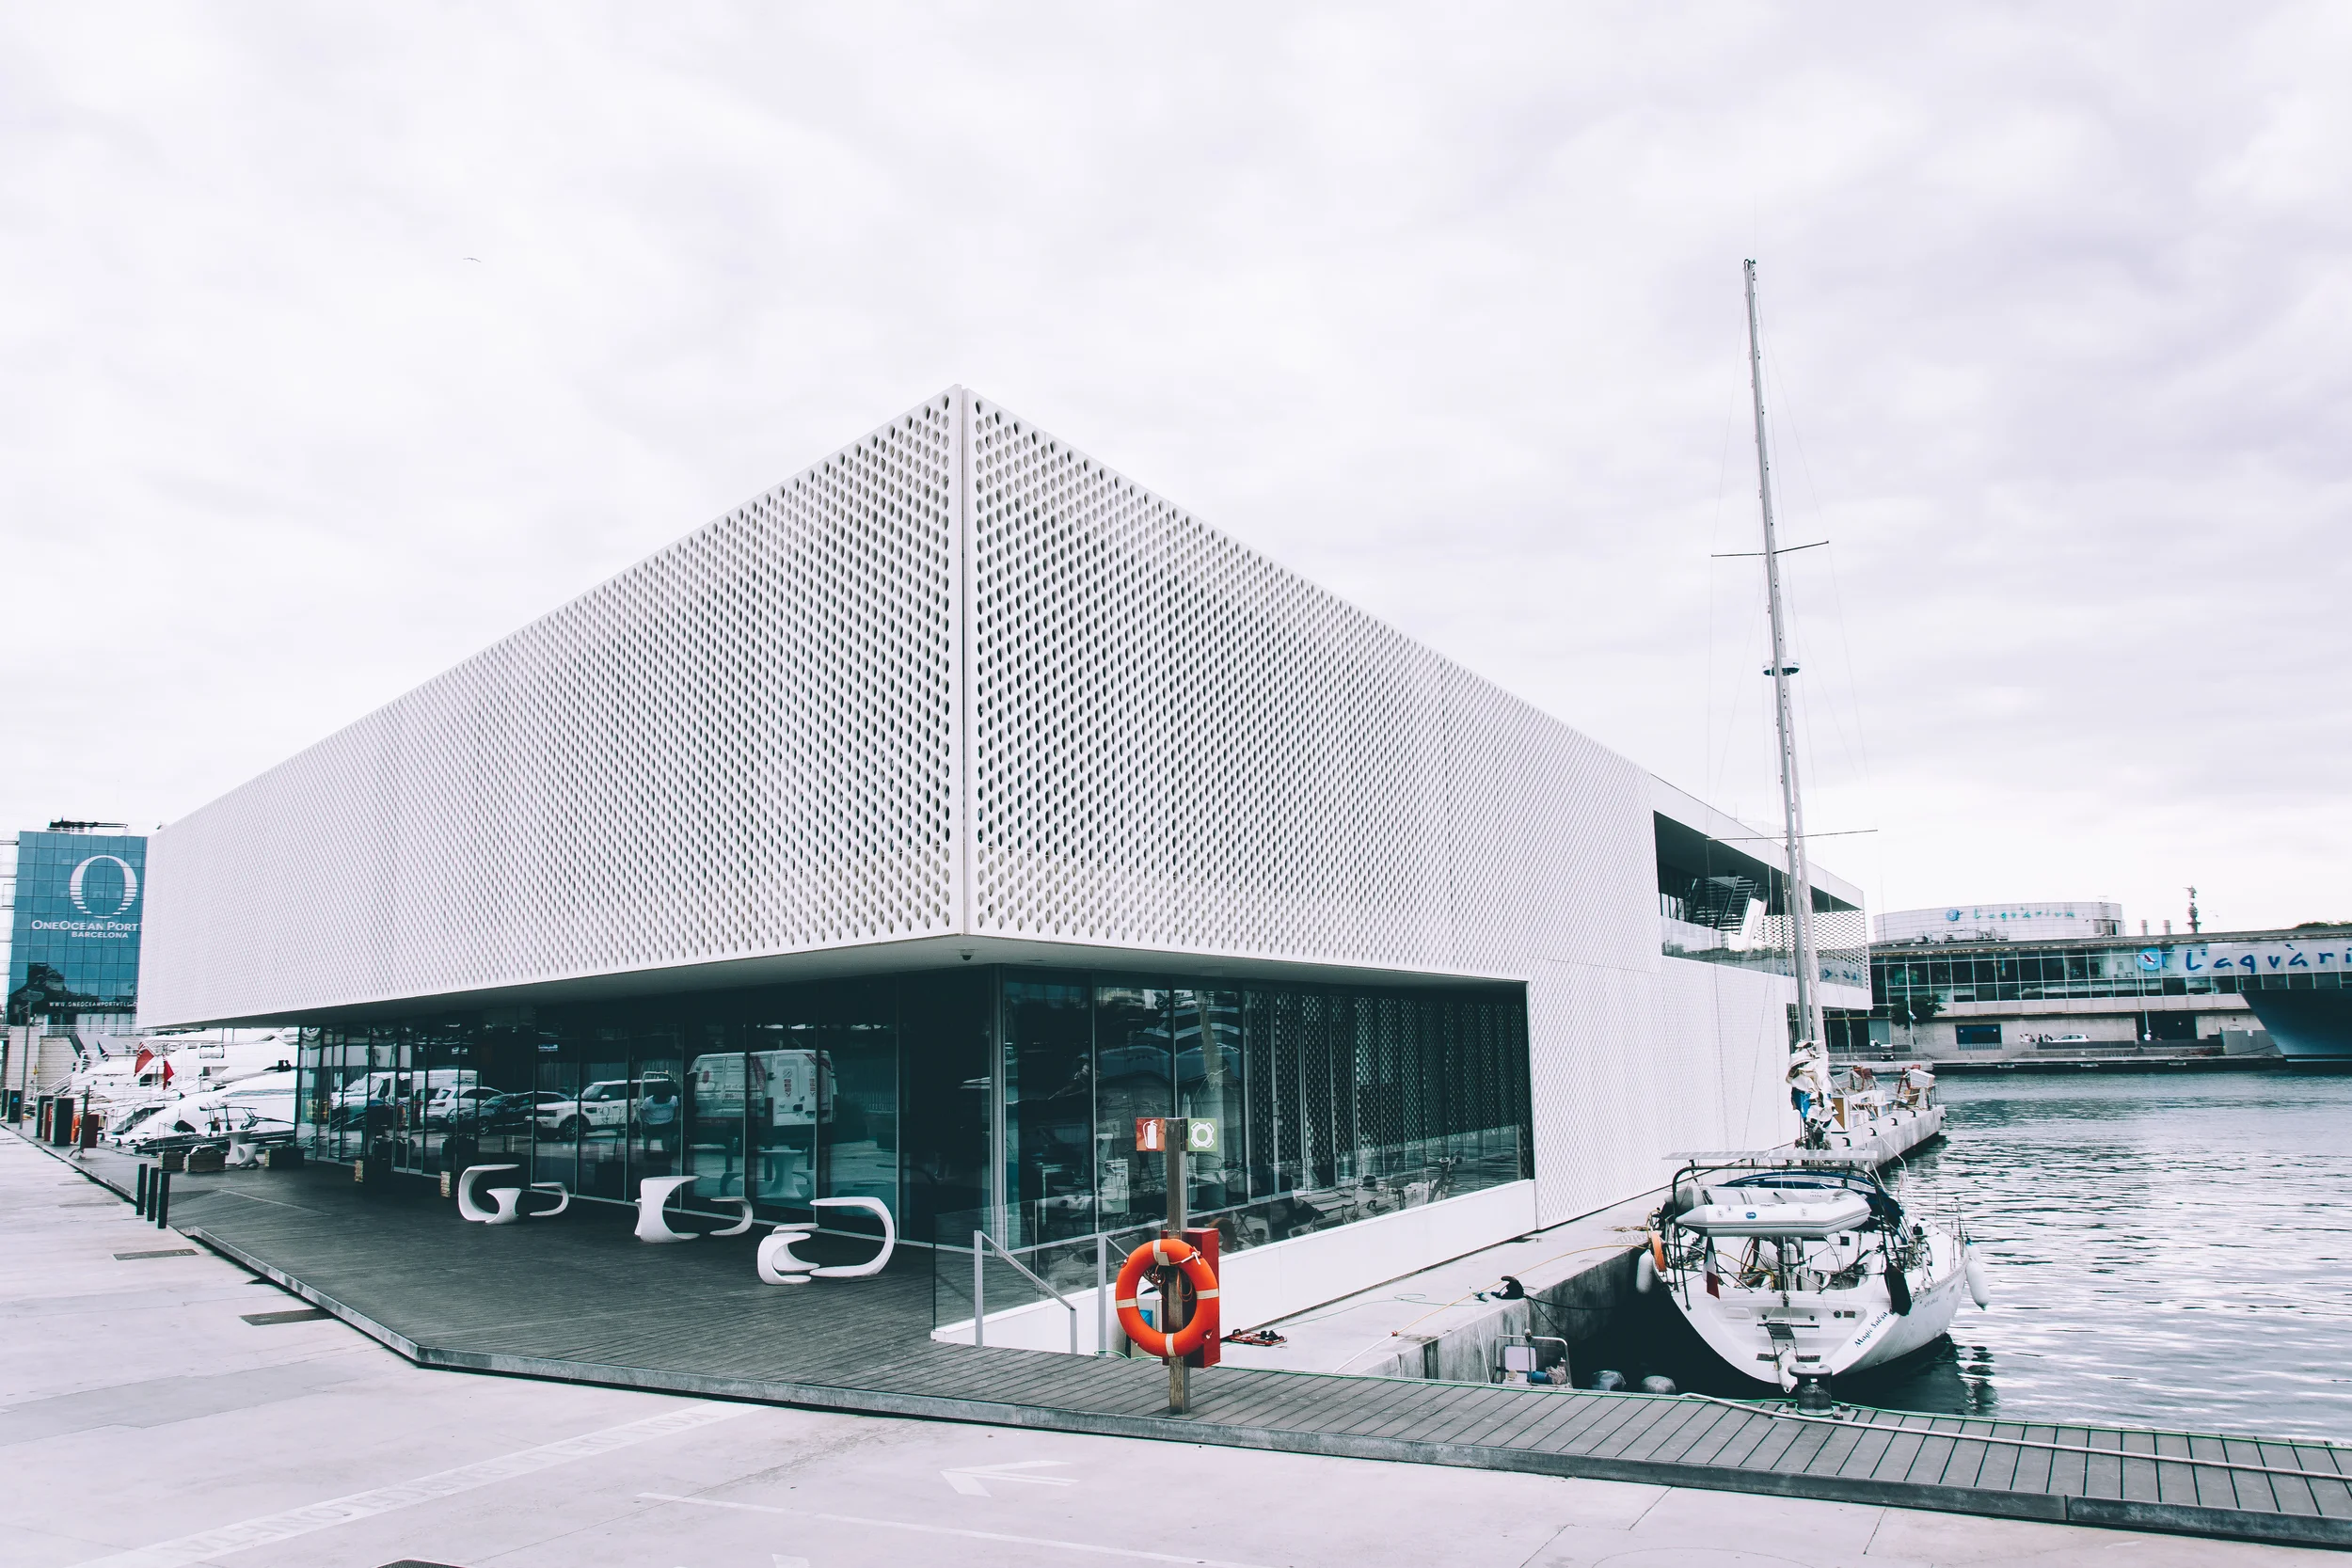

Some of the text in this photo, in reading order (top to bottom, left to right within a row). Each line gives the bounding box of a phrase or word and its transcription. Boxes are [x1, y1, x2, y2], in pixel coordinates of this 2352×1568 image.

[106, 921, 138, 931] PORT
[1854, 1311, 1888, 1348] Magic Salsa
